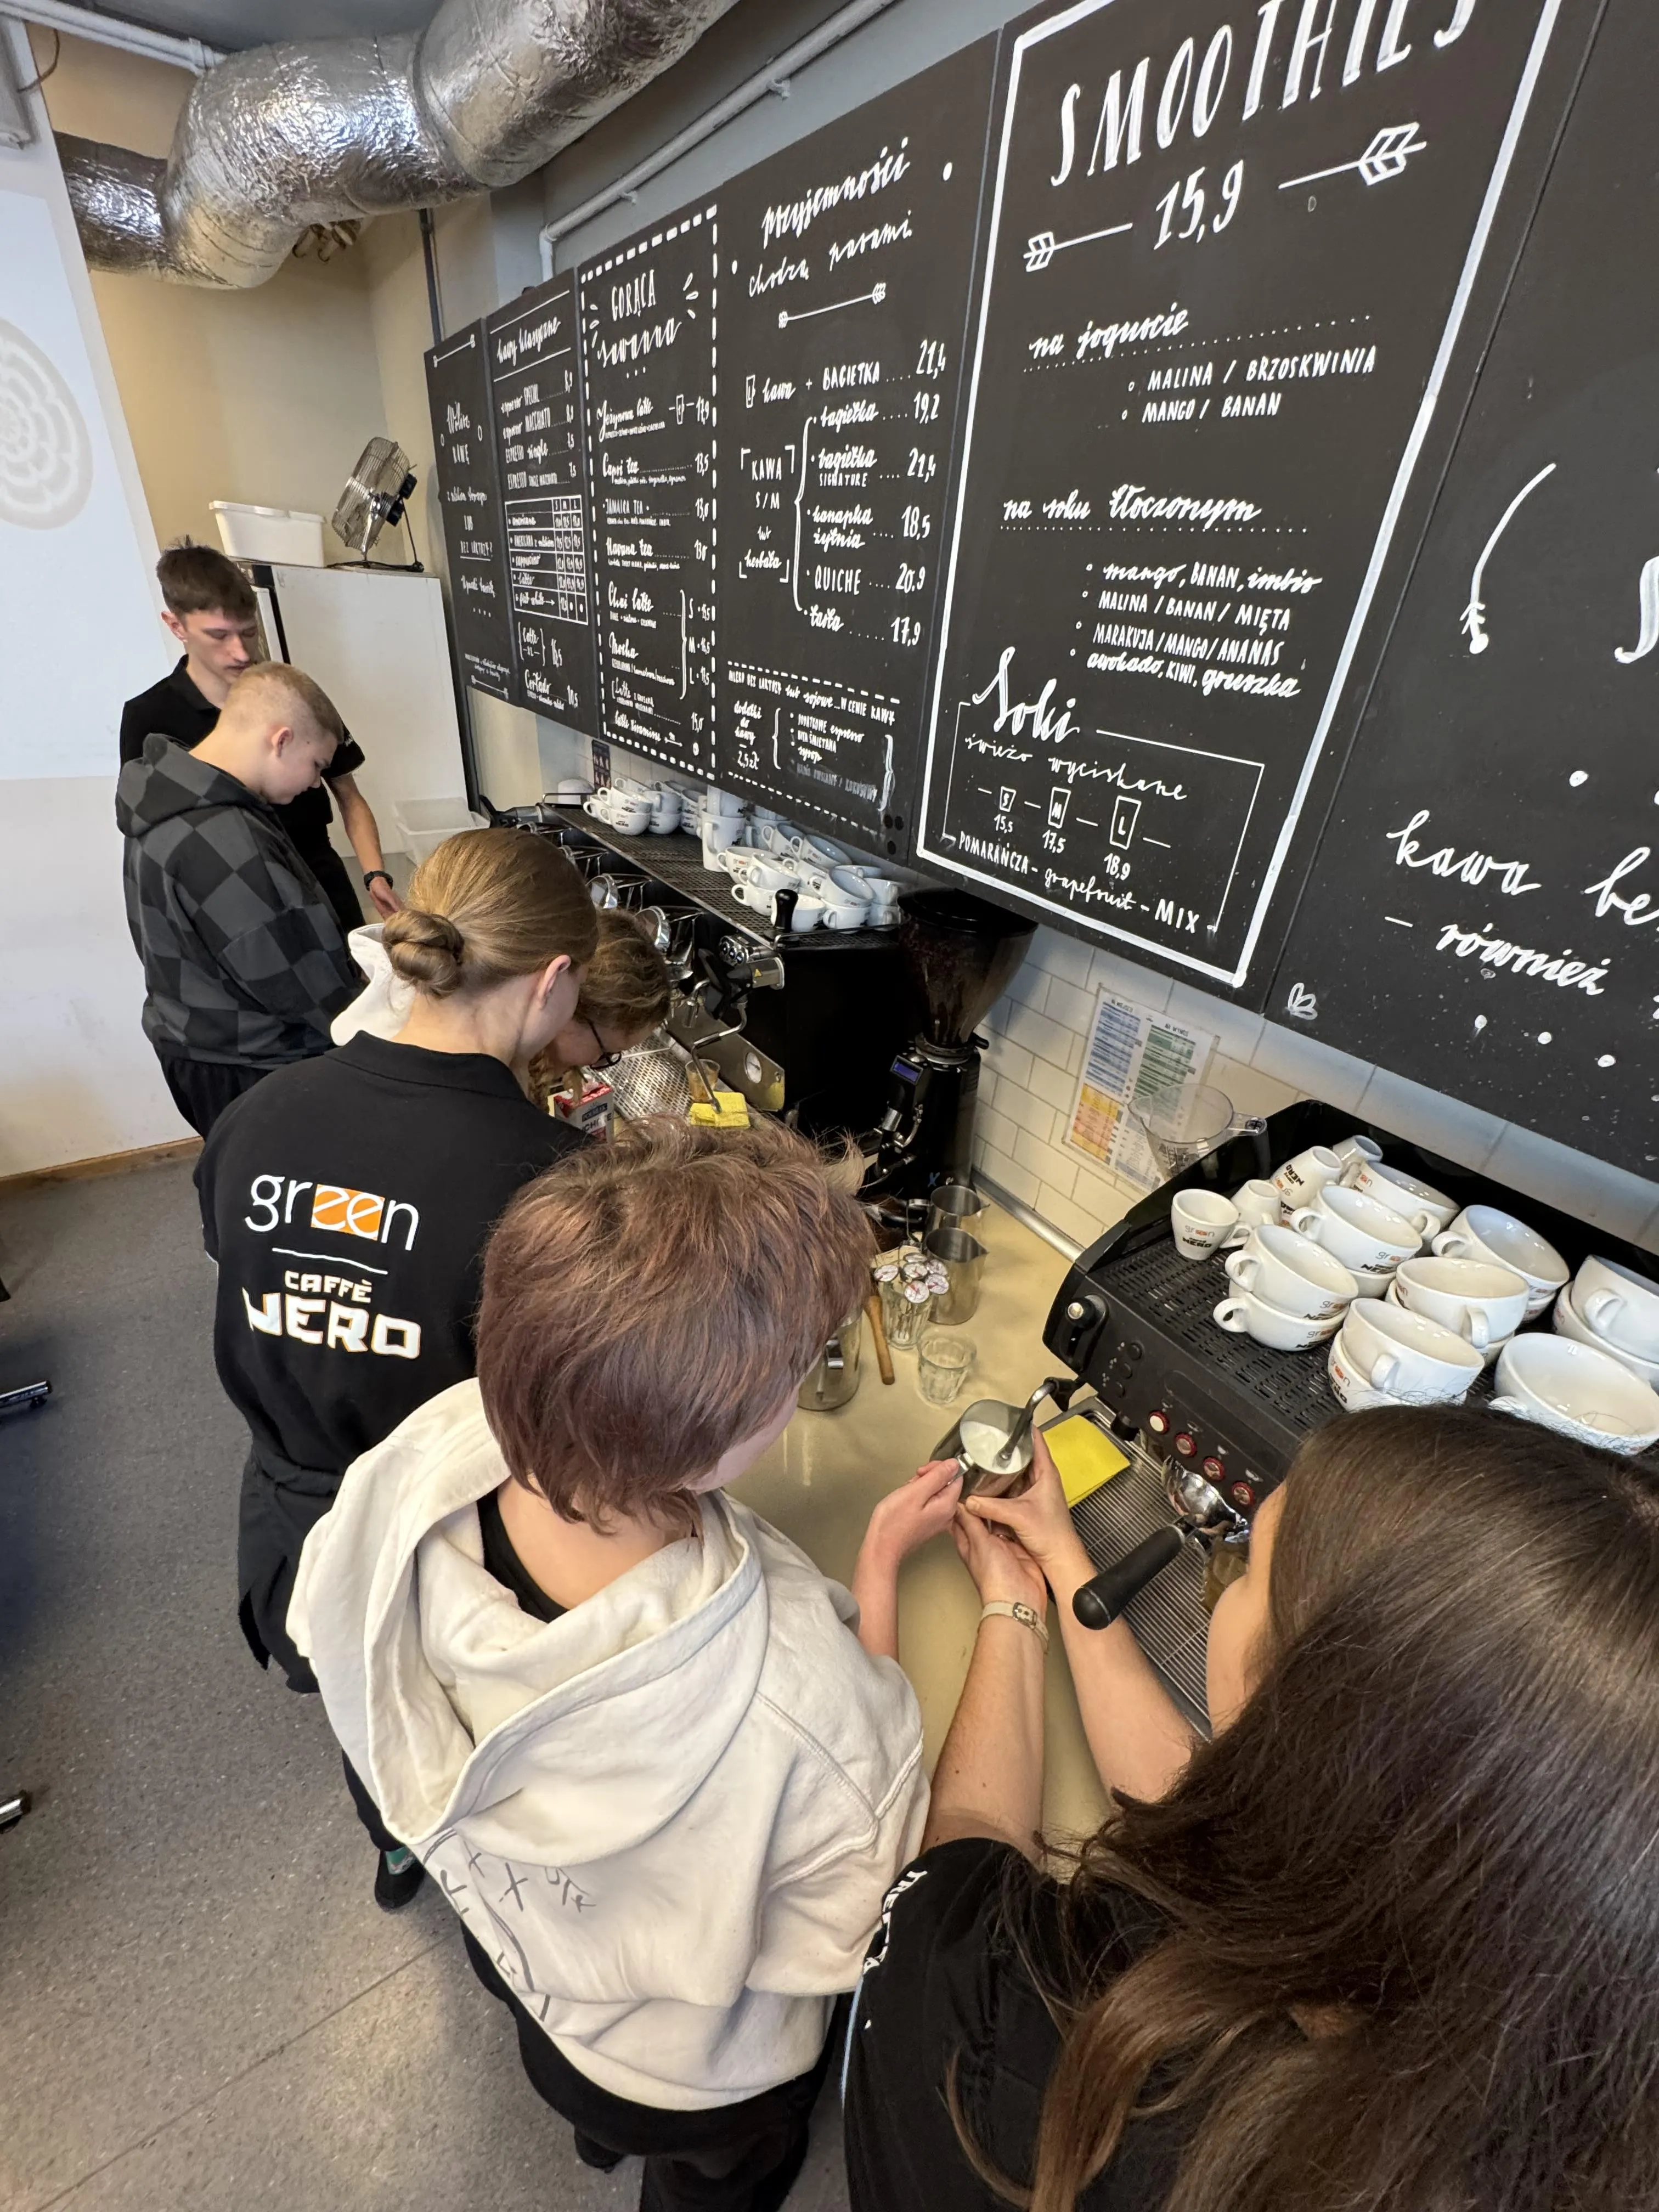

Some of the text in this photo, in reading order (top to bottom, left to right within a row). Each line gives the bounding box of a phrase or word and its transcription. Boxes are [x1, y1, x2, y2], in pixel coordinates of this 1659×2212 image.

[761, 136, 911, 250] przyjemności
[1153, 160, 1244, 251] 15,9
[749, 210, 912, 297] chodzą parami
[612, 269, 656, 321] GORĄCA
[1029, 302, 1190, 359] na jogurcie
[763, 377, 796, 403] kawa
[823, 361, 880, 391] BAGIETKA
[916, 338, 946, 380] 21,4
[1147, 362, 1214, 392] MALINA
[1246, 345, 1377, 382] BRZOSKWINIA
[820, 391, 940, 433] bagietka 19,2
[1142, 398, 1195, 423] MANGO
[1221, 392, 1282, 417] BANAN
[603, 452, 623, 483] Capri
[626, 457, 640, 474] tea
[751, 456, 782, 481] KAWA
[819, 444, 936, 483] bagietka 21,4
[819, 473, 868, 488] SIGNATURE
[605, 498, 630, 515] JAMAICA
[633, 500, 644, 515] TEA
[812, 504, 930, 540] kanapka 18,5
[1003, 483, 1262, 529] na soku tłoczonym
[606, 537, 637, 556] Havana
[639, 538, 653, 557] tea
[757, 526, 771, 540] lub
[813, 527, 866, 552] żytnia
[744, 549, 782, 569] herbata
[608, 580, 628, 610] Chai
[689, 598, 693, 619] S
[815, 565, 861, 595] QUICHE
[810, 604, 921, 647] tarta 17,9
[1098, 590, 1148, 613] MALINA
[1165, 597, 1217, 623] BANAN
[1234, 603, 1291, 636] MIĘTA
[609, 631, 696, 659] Mocha M
[1093, 622, 1155, 652] MARAKUJA
[1164, 634, 1208, 659] MANGO
[1217, 639, 1285, 667] ANANAS
[689, 667, 695, 685] L
[972, 646, 1080, 743] Soki
[1201, 668, 1302, 699] gruszka
[728, 670, 745, 684] MLEKO
[747, 674, 757, 687] BEZ
[759, 677, 782, 695] LAKTOZY
[785, 685, 800, 699] lub
[840, 697, 848, 710] W
[848, 698, 867, 717] CENIE
[871, 705, 895, 726] KAWY
[733, 700, 763, 720] dodatki
[798, 713, 865, 743] DODATKOWE espresso
[798, 730, 837, 753] BITA ŚMIETANA
[798, 746, 823, 764] syrop
[964, 733, 1188, 802] świeżo wyciskane
[1052, 803, 1062, 820] M
[1118, 817, 1126, 835] L
[994, 814, 1131, 882] 15,5 17,5 18,9
[1386, 809, 1659, 926] kawa be
[958, 831, 1201, 934] POMARAŃCZA grapefruit MIX
[1435, 922, 1609, 996] również
[244, 1175, 419, 1251] green
[1184, 1224, 1215, 1237] green
[1182, 1237, 1212, 1248] NERO
[285, 1269, 374, 1304] CAFFÈ
[241, 1287, 421, 1359] NERO
